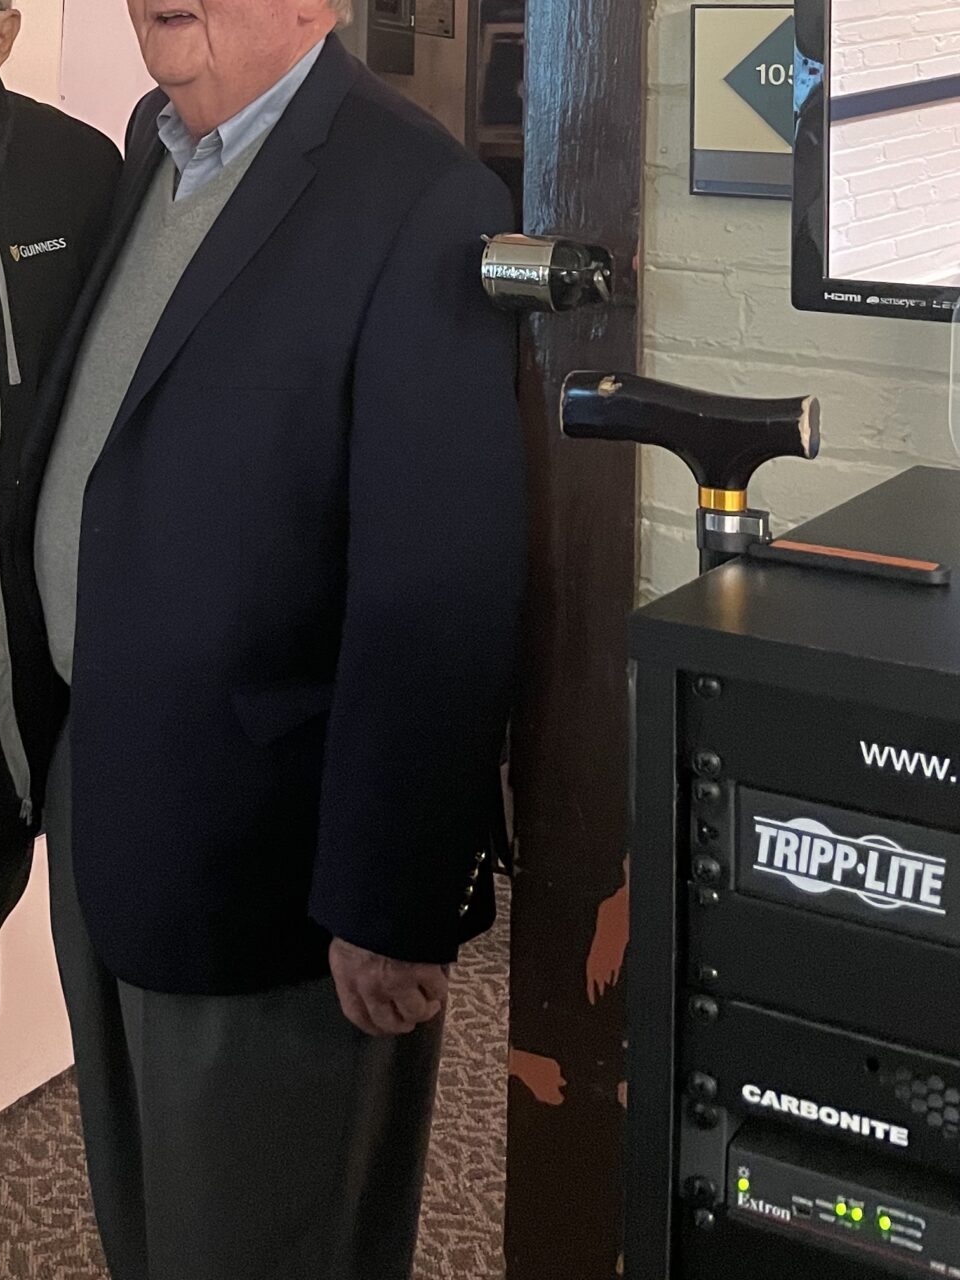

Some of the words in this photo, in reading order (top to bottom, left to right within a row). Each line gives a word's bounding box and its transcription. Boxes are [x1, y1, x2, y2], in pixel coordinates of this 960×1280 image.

[19, 238, 66, 257] GUINNESS
[824, 292, 861, 302] HDMI
[859, 740, 957, 782] www.
[741, 1084, 909, 1147] CARBONITE
[738, 1191, 791, 1221] Extron
